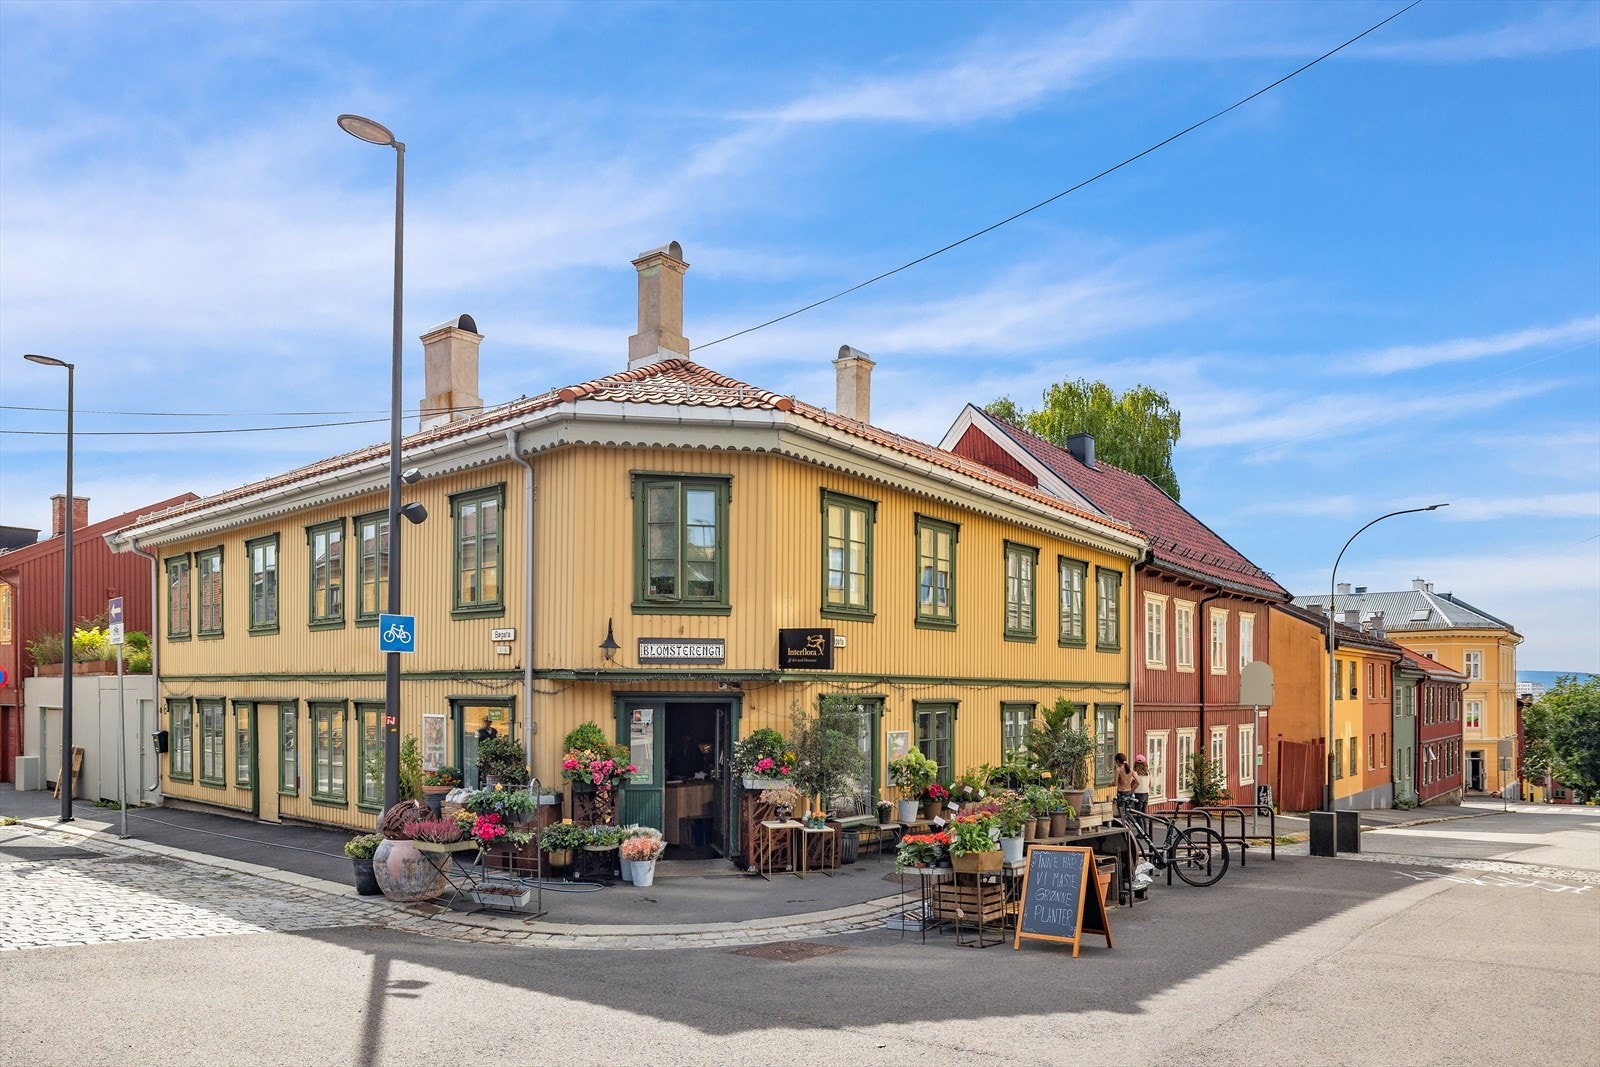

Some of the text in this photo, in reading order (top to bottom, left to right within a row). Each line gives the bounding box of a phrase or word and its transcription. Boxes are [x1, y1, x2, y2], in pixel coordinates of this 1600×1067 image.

[643, 645, 721, 656] BLOMSTERENGA
[787, 647, 817, 656] Interflora
[1038, 855, 1078, 870] INNE HAR
[1036, 871, 1077, 888] VI MASSE
[1035, 888, 1073, 906] GRØNNE
[1034, 905, 1073, 927] PLANTER
